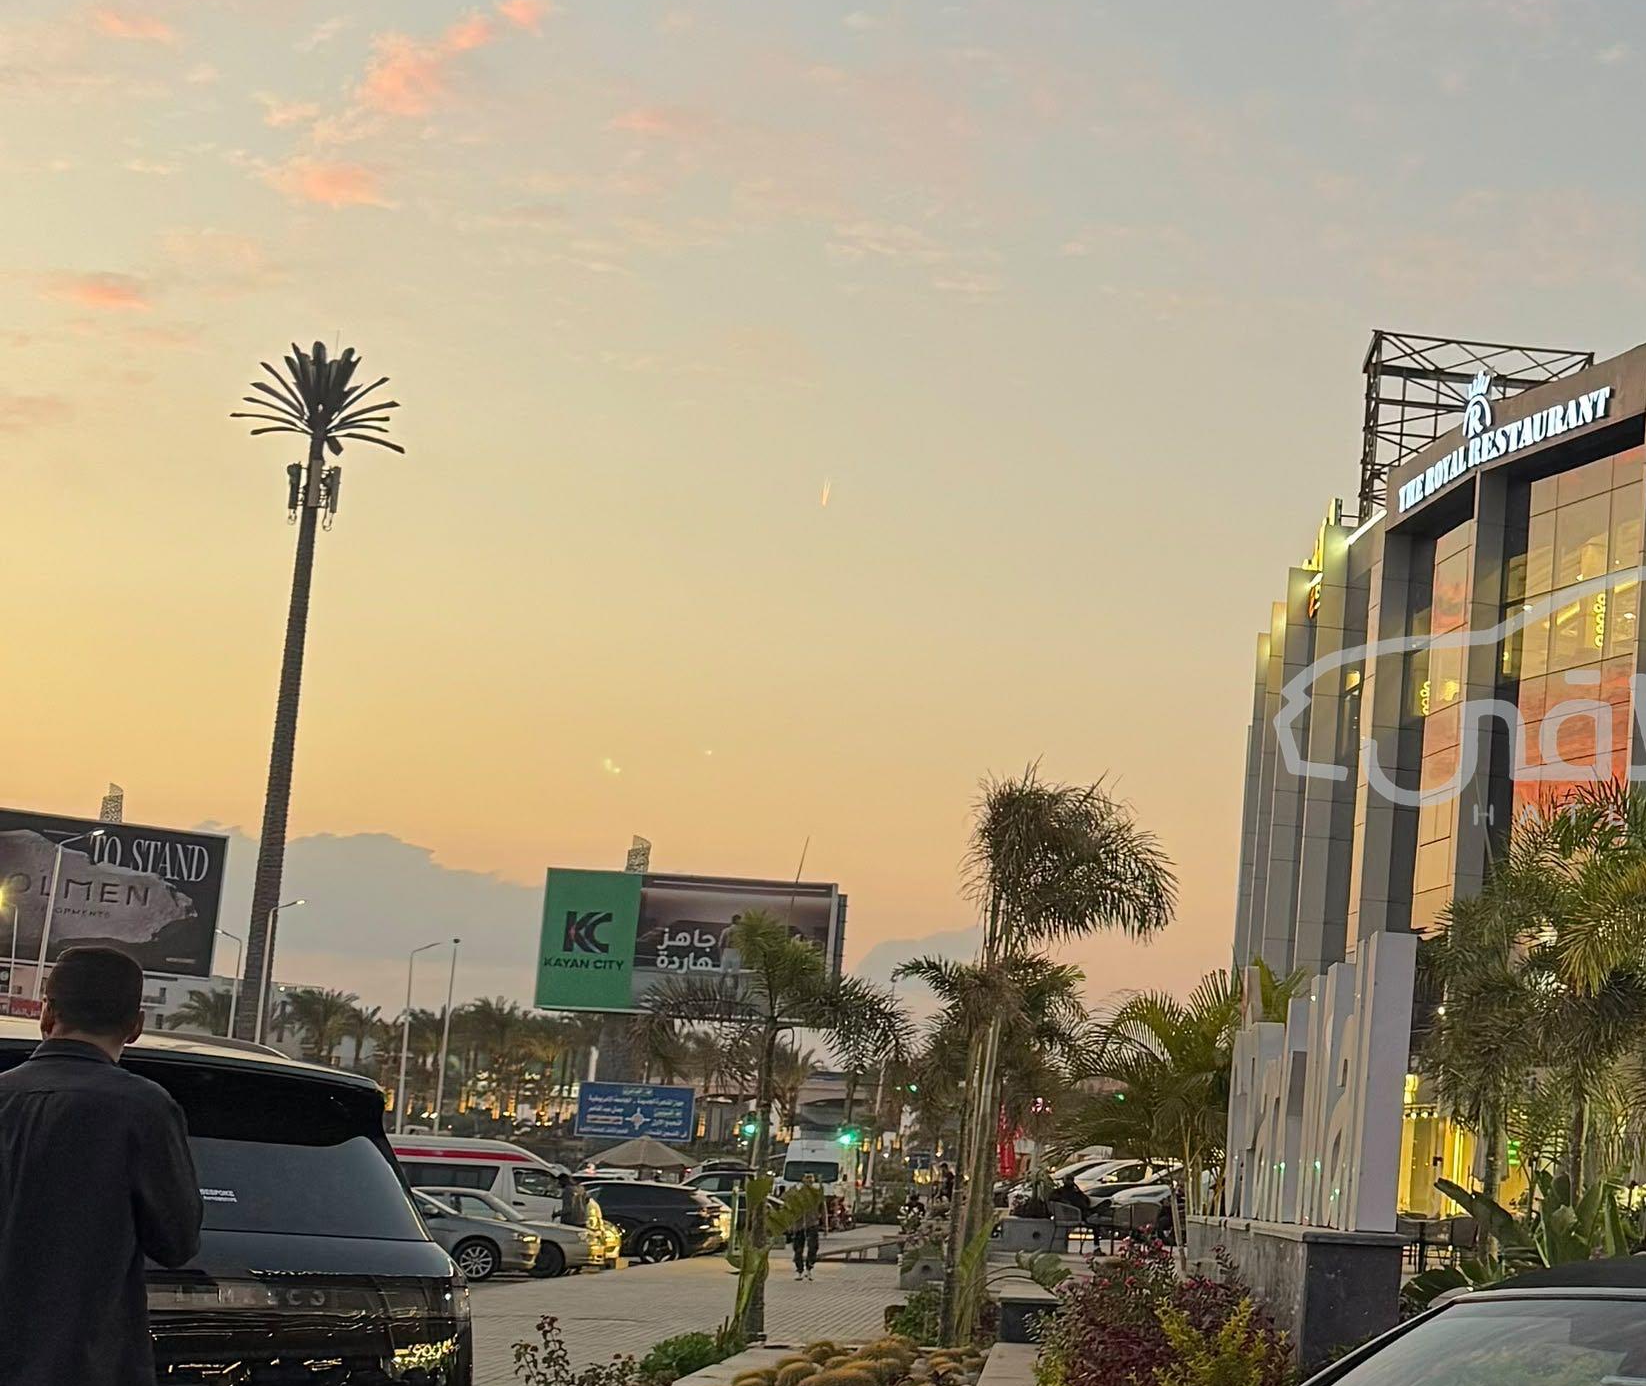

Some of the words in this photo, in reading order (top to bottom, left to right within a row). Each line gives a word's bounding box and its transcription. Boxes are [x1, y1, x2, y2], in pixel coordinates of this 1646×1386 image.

[1399, 474, 1425, 513] THE
[1425, 445, 1467, 496] ROYAL
[1467, 386, 1611, 468] RESTAURANT
[90, 834, 122, 867] TO
[132, 839, 210, 882] STAND
[656, 927, 717, 952] جاهز
[544, 957, 590, 970] KAYAN
[593, 958, 625, 971] CITY
